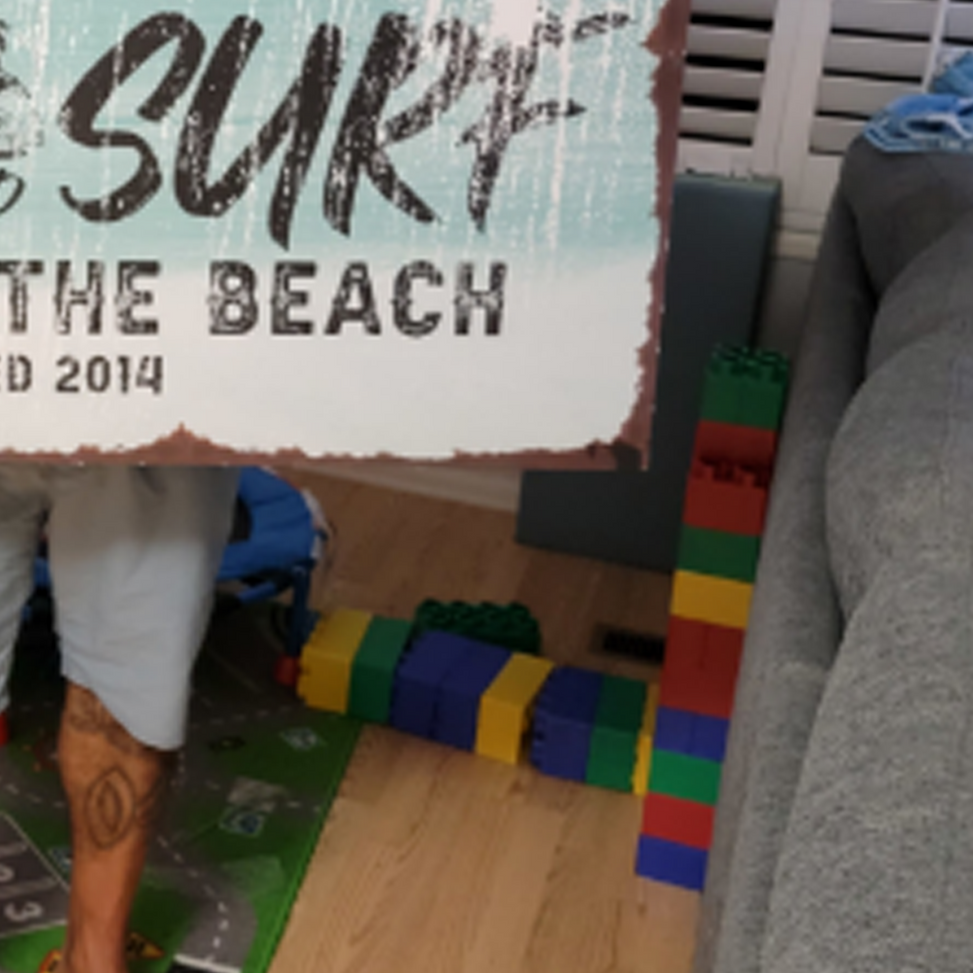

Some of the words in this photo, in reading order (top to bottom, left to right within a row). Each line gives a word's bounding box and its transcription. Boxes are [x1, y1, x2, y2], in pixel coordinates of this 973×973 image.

[57, 7, 632, 252] SURF
[207, 259, 508, 337] BEACH
[54, 354, 164, 395] 2014
[3, 899, 45, 924] 3
